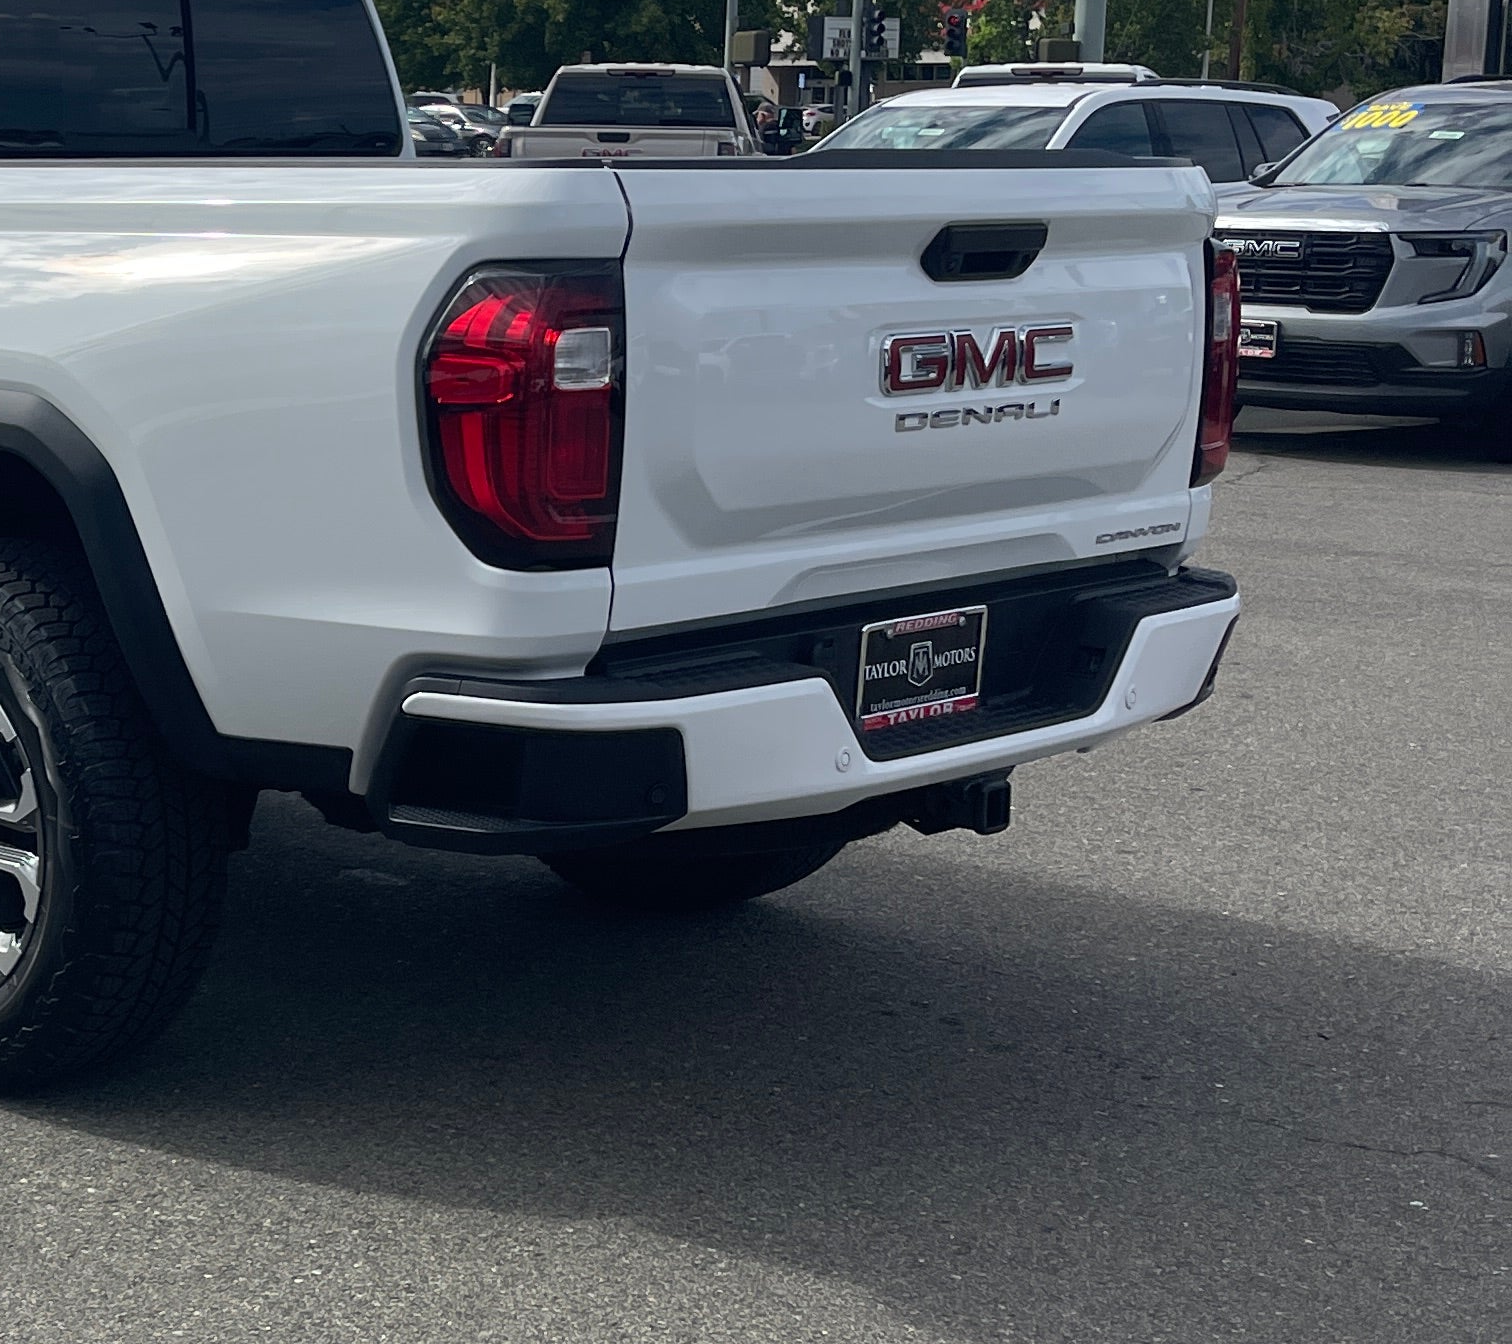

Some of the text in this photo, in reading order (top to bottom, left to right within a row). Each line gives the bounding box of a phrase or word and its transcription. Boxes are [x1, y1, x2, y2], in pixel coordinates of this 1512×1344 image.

[879, 321, 1074, 397] GMC
[895, 398, 1061, 432] DENALI
[895, 613, 958, 633] REDDING
[864, 659, 908, 681] TAYLOR
[932, 646, 977, 669] MOTORS
